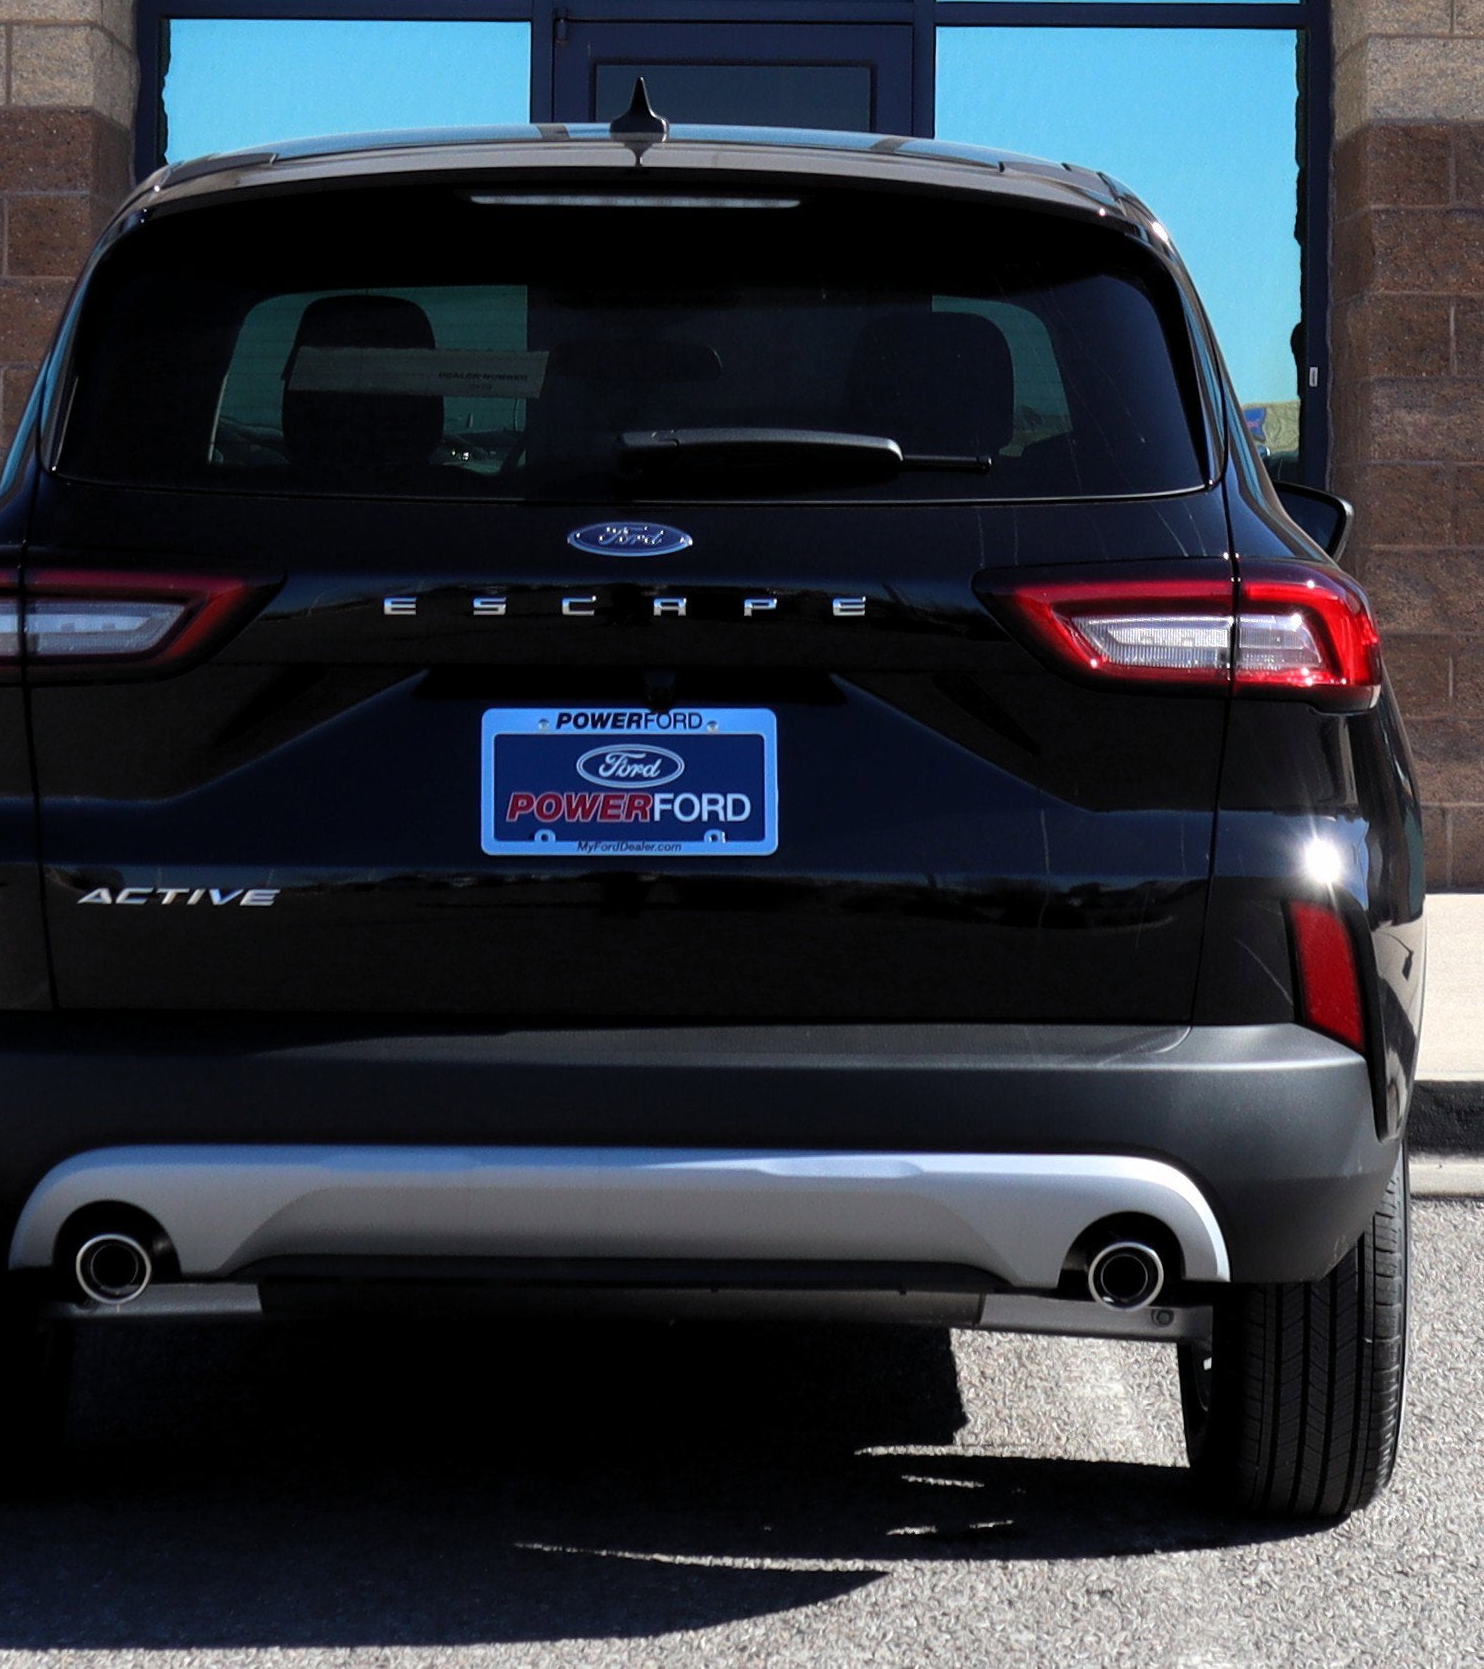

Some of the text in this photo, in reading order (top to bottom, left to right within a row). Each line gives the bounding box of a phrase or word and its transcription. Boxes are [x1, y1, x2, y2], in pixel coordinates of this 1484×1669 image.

[599, 527, 664, 545] Ford
[383, 596, 866, 616] ESCAPE
[598, 751, 661, 778] Ford
[577, 841, 682, 853] MyFordDealer.com
[77, 887, 281, 906] ACTIVE
